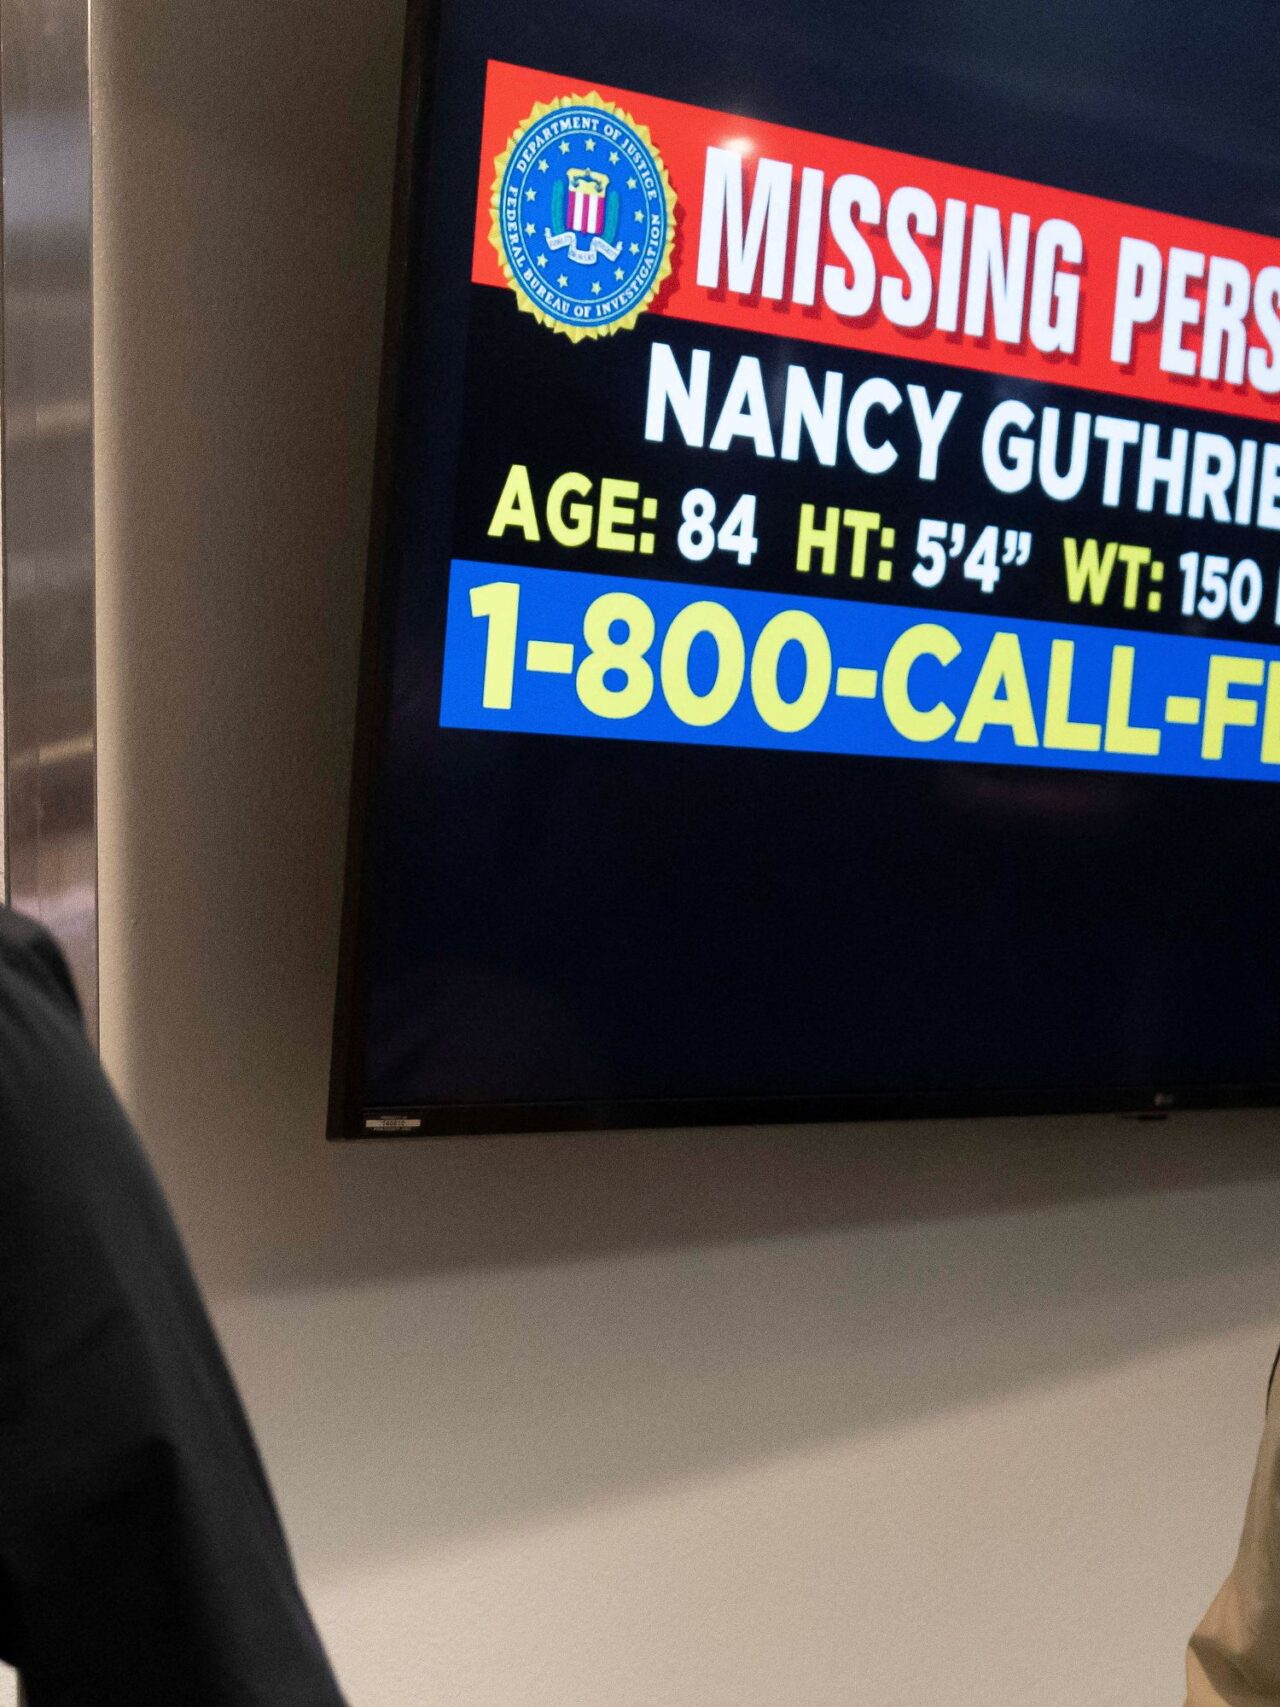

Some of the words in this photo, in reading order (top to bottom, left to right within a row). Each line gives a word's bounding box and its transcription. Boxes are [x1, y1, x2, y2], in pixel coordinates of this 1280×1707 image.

[517, 116, 599, 173] DEPARTMENT
[603, 123, 622, 140] OF
[621, 135, 657, 200] JUSTICE
[506, 185, 524, 267] FEDERAL
[523, 268, 570, 314] BUREAU
[573, 304, 591, 317] OF
[596, 214, 661, 316] INVESTIGATION
[696, 145, 1083, 354] MISSING
[644, 342, 962, 480] NANCY
[487, 464, 658, 554] AGE:
[677, 488, 758, 565] 84
[796, 503, 895, 581] HT:
[1063, 537, 1164, 611] WT:
[1179, 552, 1262, 622] 150
